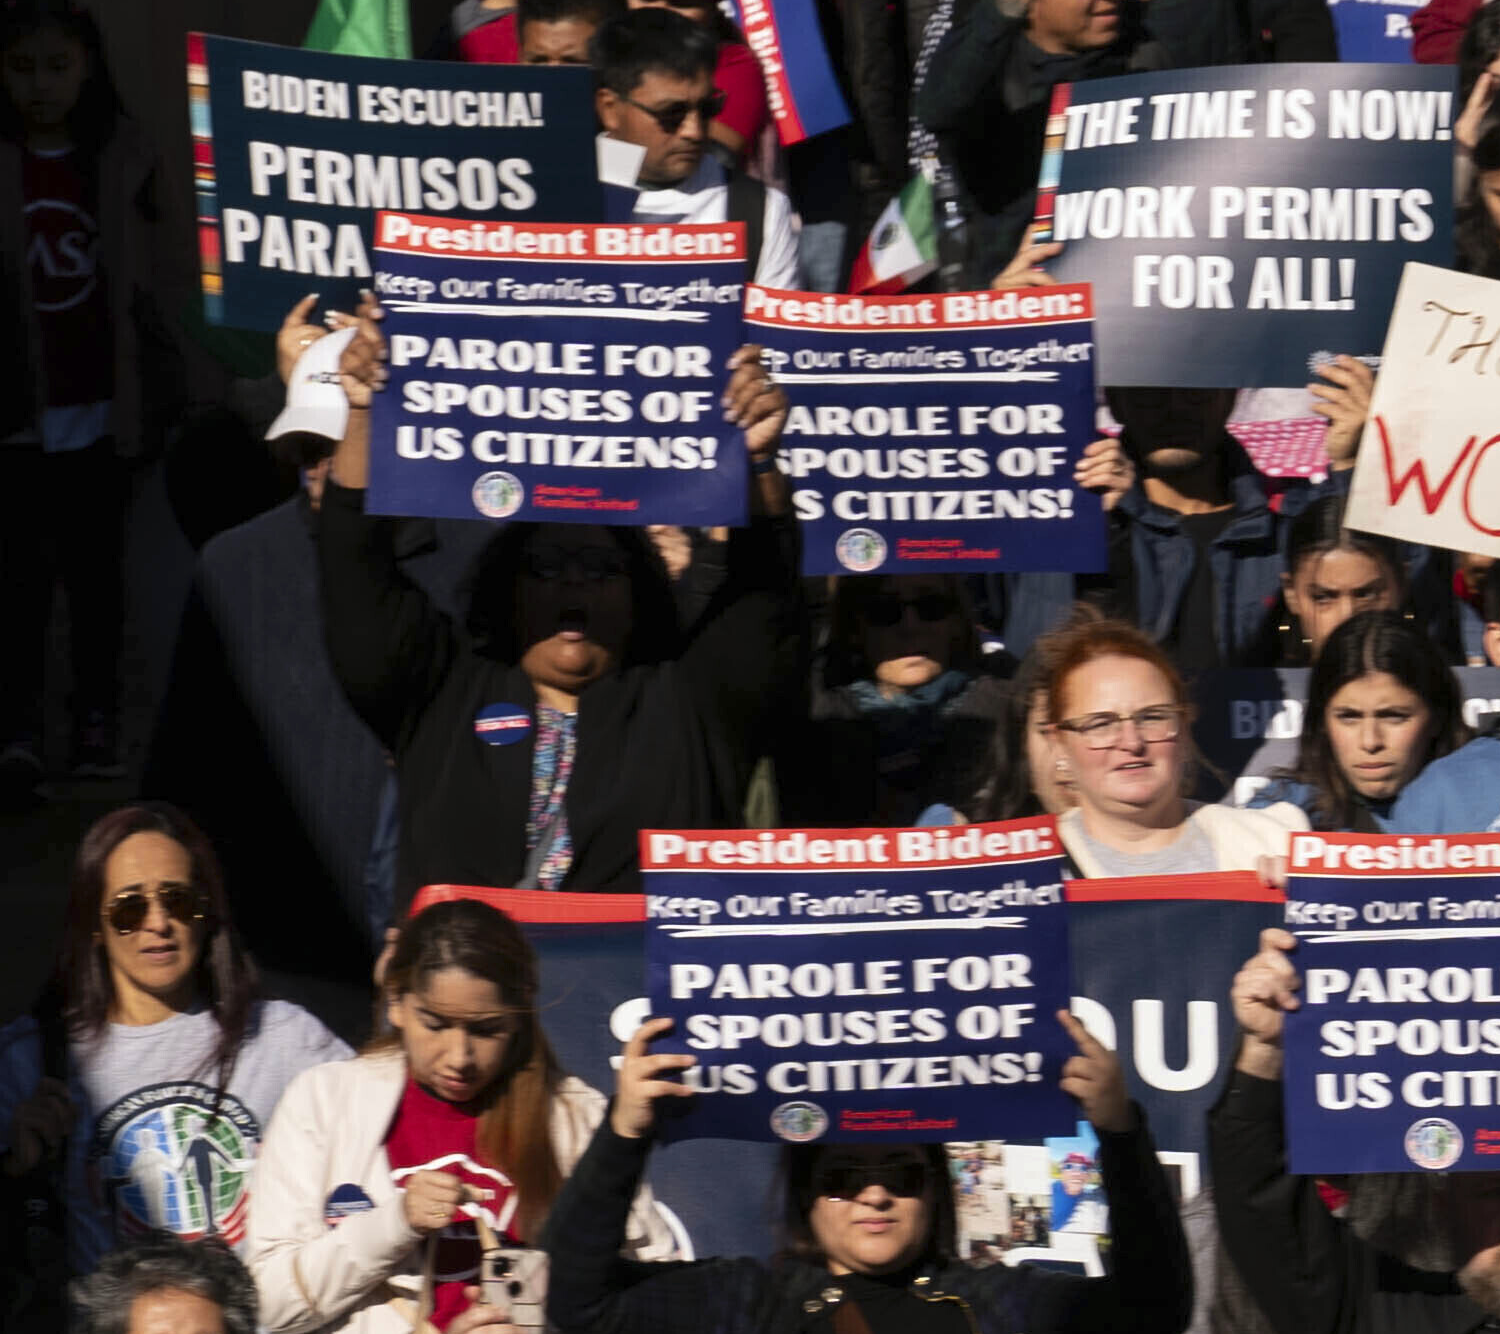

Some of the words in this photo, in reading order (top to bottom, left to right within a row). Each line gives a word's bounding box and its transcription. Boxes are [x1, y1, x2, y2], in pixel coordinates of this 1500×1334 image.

[241, 70, 351, 119] BIDEN
[358, 85, 544, 128] ESCUCHA!
[1064, 96, 1140, 152] THE
[1150, 89, 1257, 140] TIME
[1265, 88, 1318, 139] IS
[1326, 88, 1452, 141] NOW!
[248, 141, 536, 212] PERMISOS
[381, 214, 591, 258] President
[595, 223, 736, 258] Biden:
[1053, 186, 1195, 243] WORK
[1209, 187, 1434, 244] PERMITS
[222, 208, 372, 278] PARA
[1131, 255, 1234, 310] FOR
[1248, 257, 1356, 311] ALL!
[391, 335, 595, 375] PAROLE
[603, 345, 711, 377] FOR
[402, 381, 633, 422] SPOUSES
[642, 390, 711, 423] OF
[397, 425, 464, 460] US
[472, 429, 718, 469] CITIZENS!
[1286, 899, 1357, 928] Keep
[1364, 899, 1422, 923] Our
[670, 959, 902, 1000] PAROLE
[912, 953, 1033, 993] FOR
[1316, 1073, 1392, 1110] US
